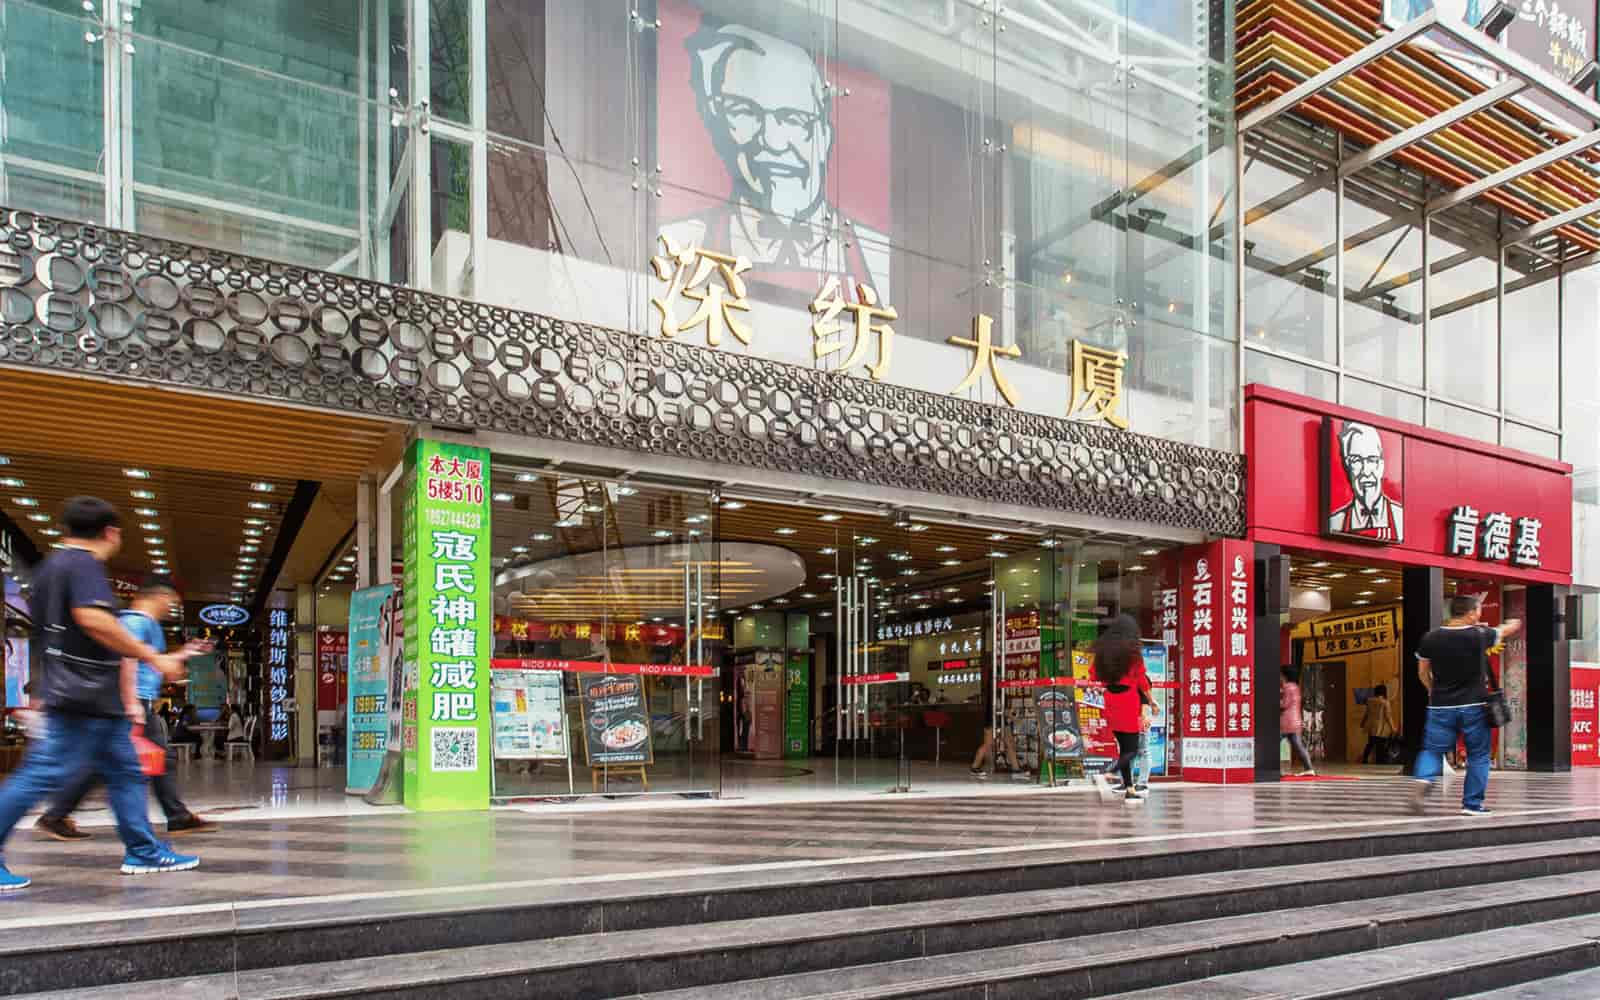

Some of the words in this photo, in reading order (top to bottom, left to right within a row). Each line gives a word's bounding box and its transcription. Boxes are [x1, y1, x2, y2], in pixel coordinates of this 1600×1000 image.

[650, 233, 1131, 430] 深纺大厦
[427, 479, 484, 504] 5楼510
[429, 455, 483, 482] 本大厦
[1449, 505, 1543, 568] 肯德基
[431, 531, 477, 721] 寇氏神罐减肥
[1192, 582, 1213, 658] 石兴凯
[1231, 579, 1248, 657] 石兴凯
[1572, 720, 1593, 734] KFC
